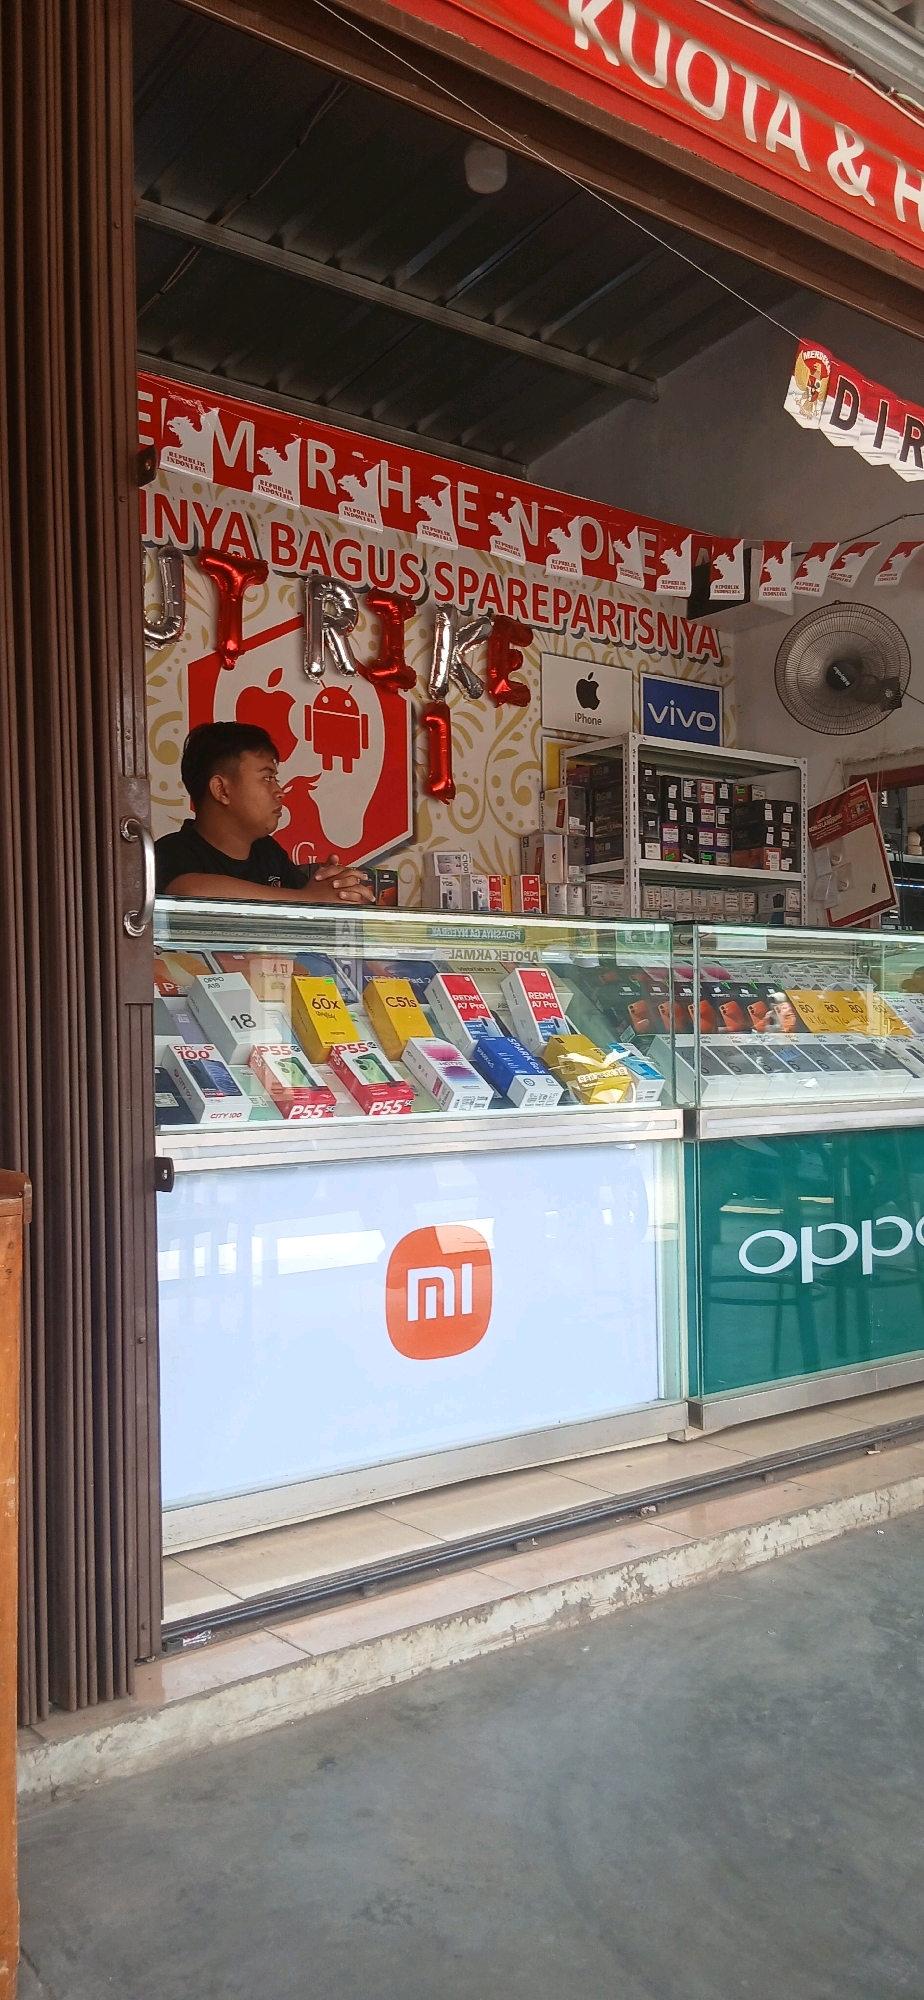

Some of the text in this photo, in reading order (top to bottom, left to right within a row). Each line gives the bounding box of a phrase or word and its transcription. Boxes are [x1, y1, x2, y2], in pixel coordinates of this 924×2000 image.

[568, 0, 812, 172] KUOTA
[827, 122, 876, 206] &
[270, 520, 422, 595] BAGUS
[434, 560, 720, 660] SPAREPARTSNYA
[573, 712, 603, 727] iPhone
[647, 699, 718, 732] vivo
[385, 996, 417, 1008] C51s
[451, 994, 481, 1002] REDMI
[527, 991, 555, 1000] REDMI
[311, 997, 341, 1010] 60x
[469, 1002, 486, 1010] Pro
[531, 1000, 541, 1008] A7
[230, 1013, 256, 1029] 18
[177, 1050, 211, 1060] 100
[256, 1045, 292, 1056] P55
[334, 1042, 369, 1055] P55
[506, 1037, 534, 1061] SPARK
[288, 1103, 327, 1119] P55
[369, 1099, 406, 1116] P55
